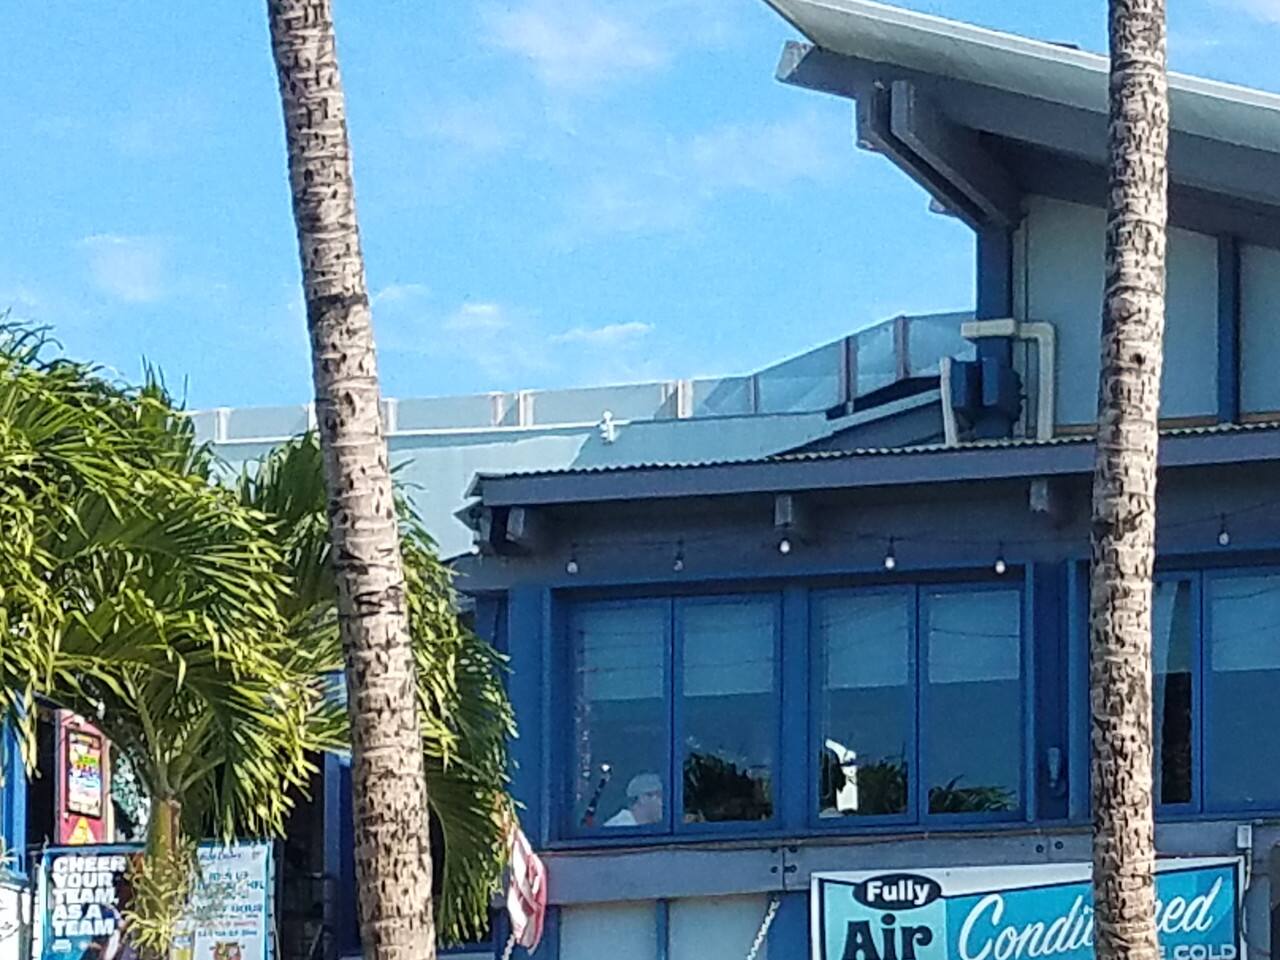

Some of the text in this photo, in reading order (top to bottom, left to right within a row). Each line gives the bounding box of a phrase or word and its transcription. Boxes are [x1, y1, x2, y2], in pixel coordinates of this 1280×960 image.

[53, 856, 127, 873] CHEER
[52, 872, 114, 889] YOUR
[866, 879, 931, 905] Fully
[52, 903, 102, 920] AS A
[52, 918, 115, 937] TEAM
